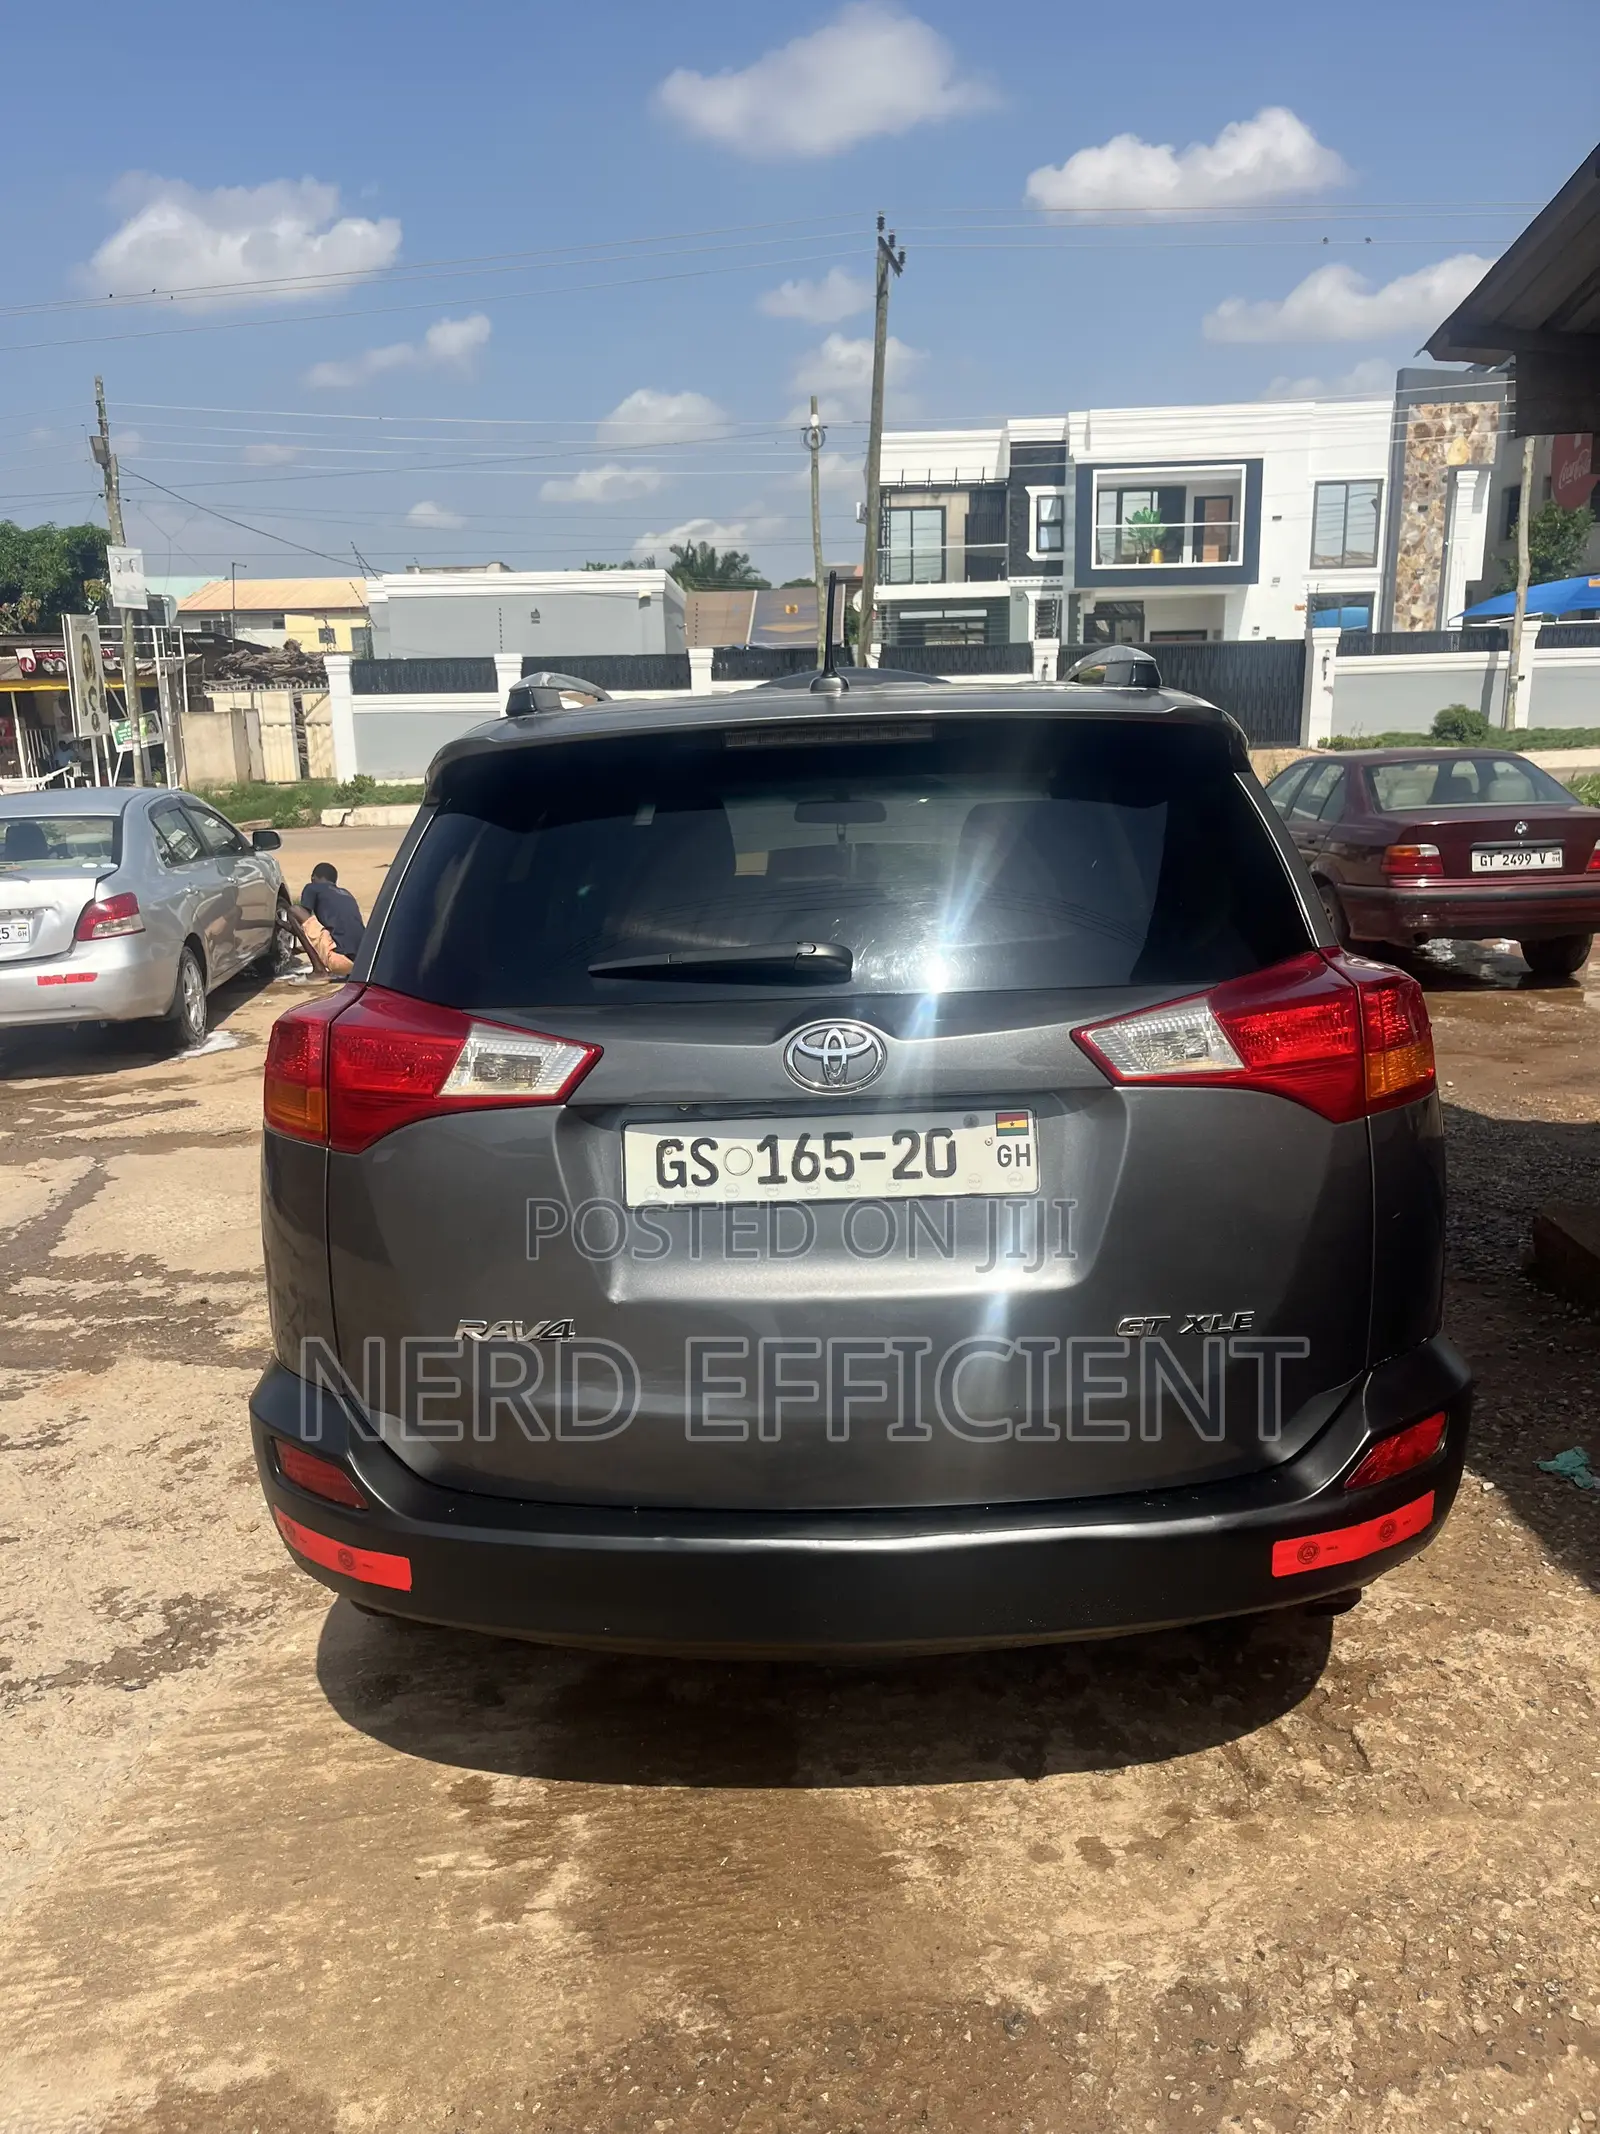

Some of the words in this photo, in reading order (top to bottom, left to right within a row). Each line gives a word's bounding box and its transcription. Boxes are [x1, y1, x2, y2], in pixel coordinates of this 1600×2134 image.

[1480, 854, 1494, 866] GT
[1502, 853, 1532, 866] 2499
[1540, 852, 1546, 864] V
[0, 927, 9, 940] 5
[656, 1137, 720, 1189] GS
[757, 1127, 957, 1185] 165-20
[997, 1143, 1031, 1167] GH
[453, 1318, 576, 1343] RAV4
[1116, 1315, 1171, 1337] GT
[1179, 1310, 1255, 1335] XLE
